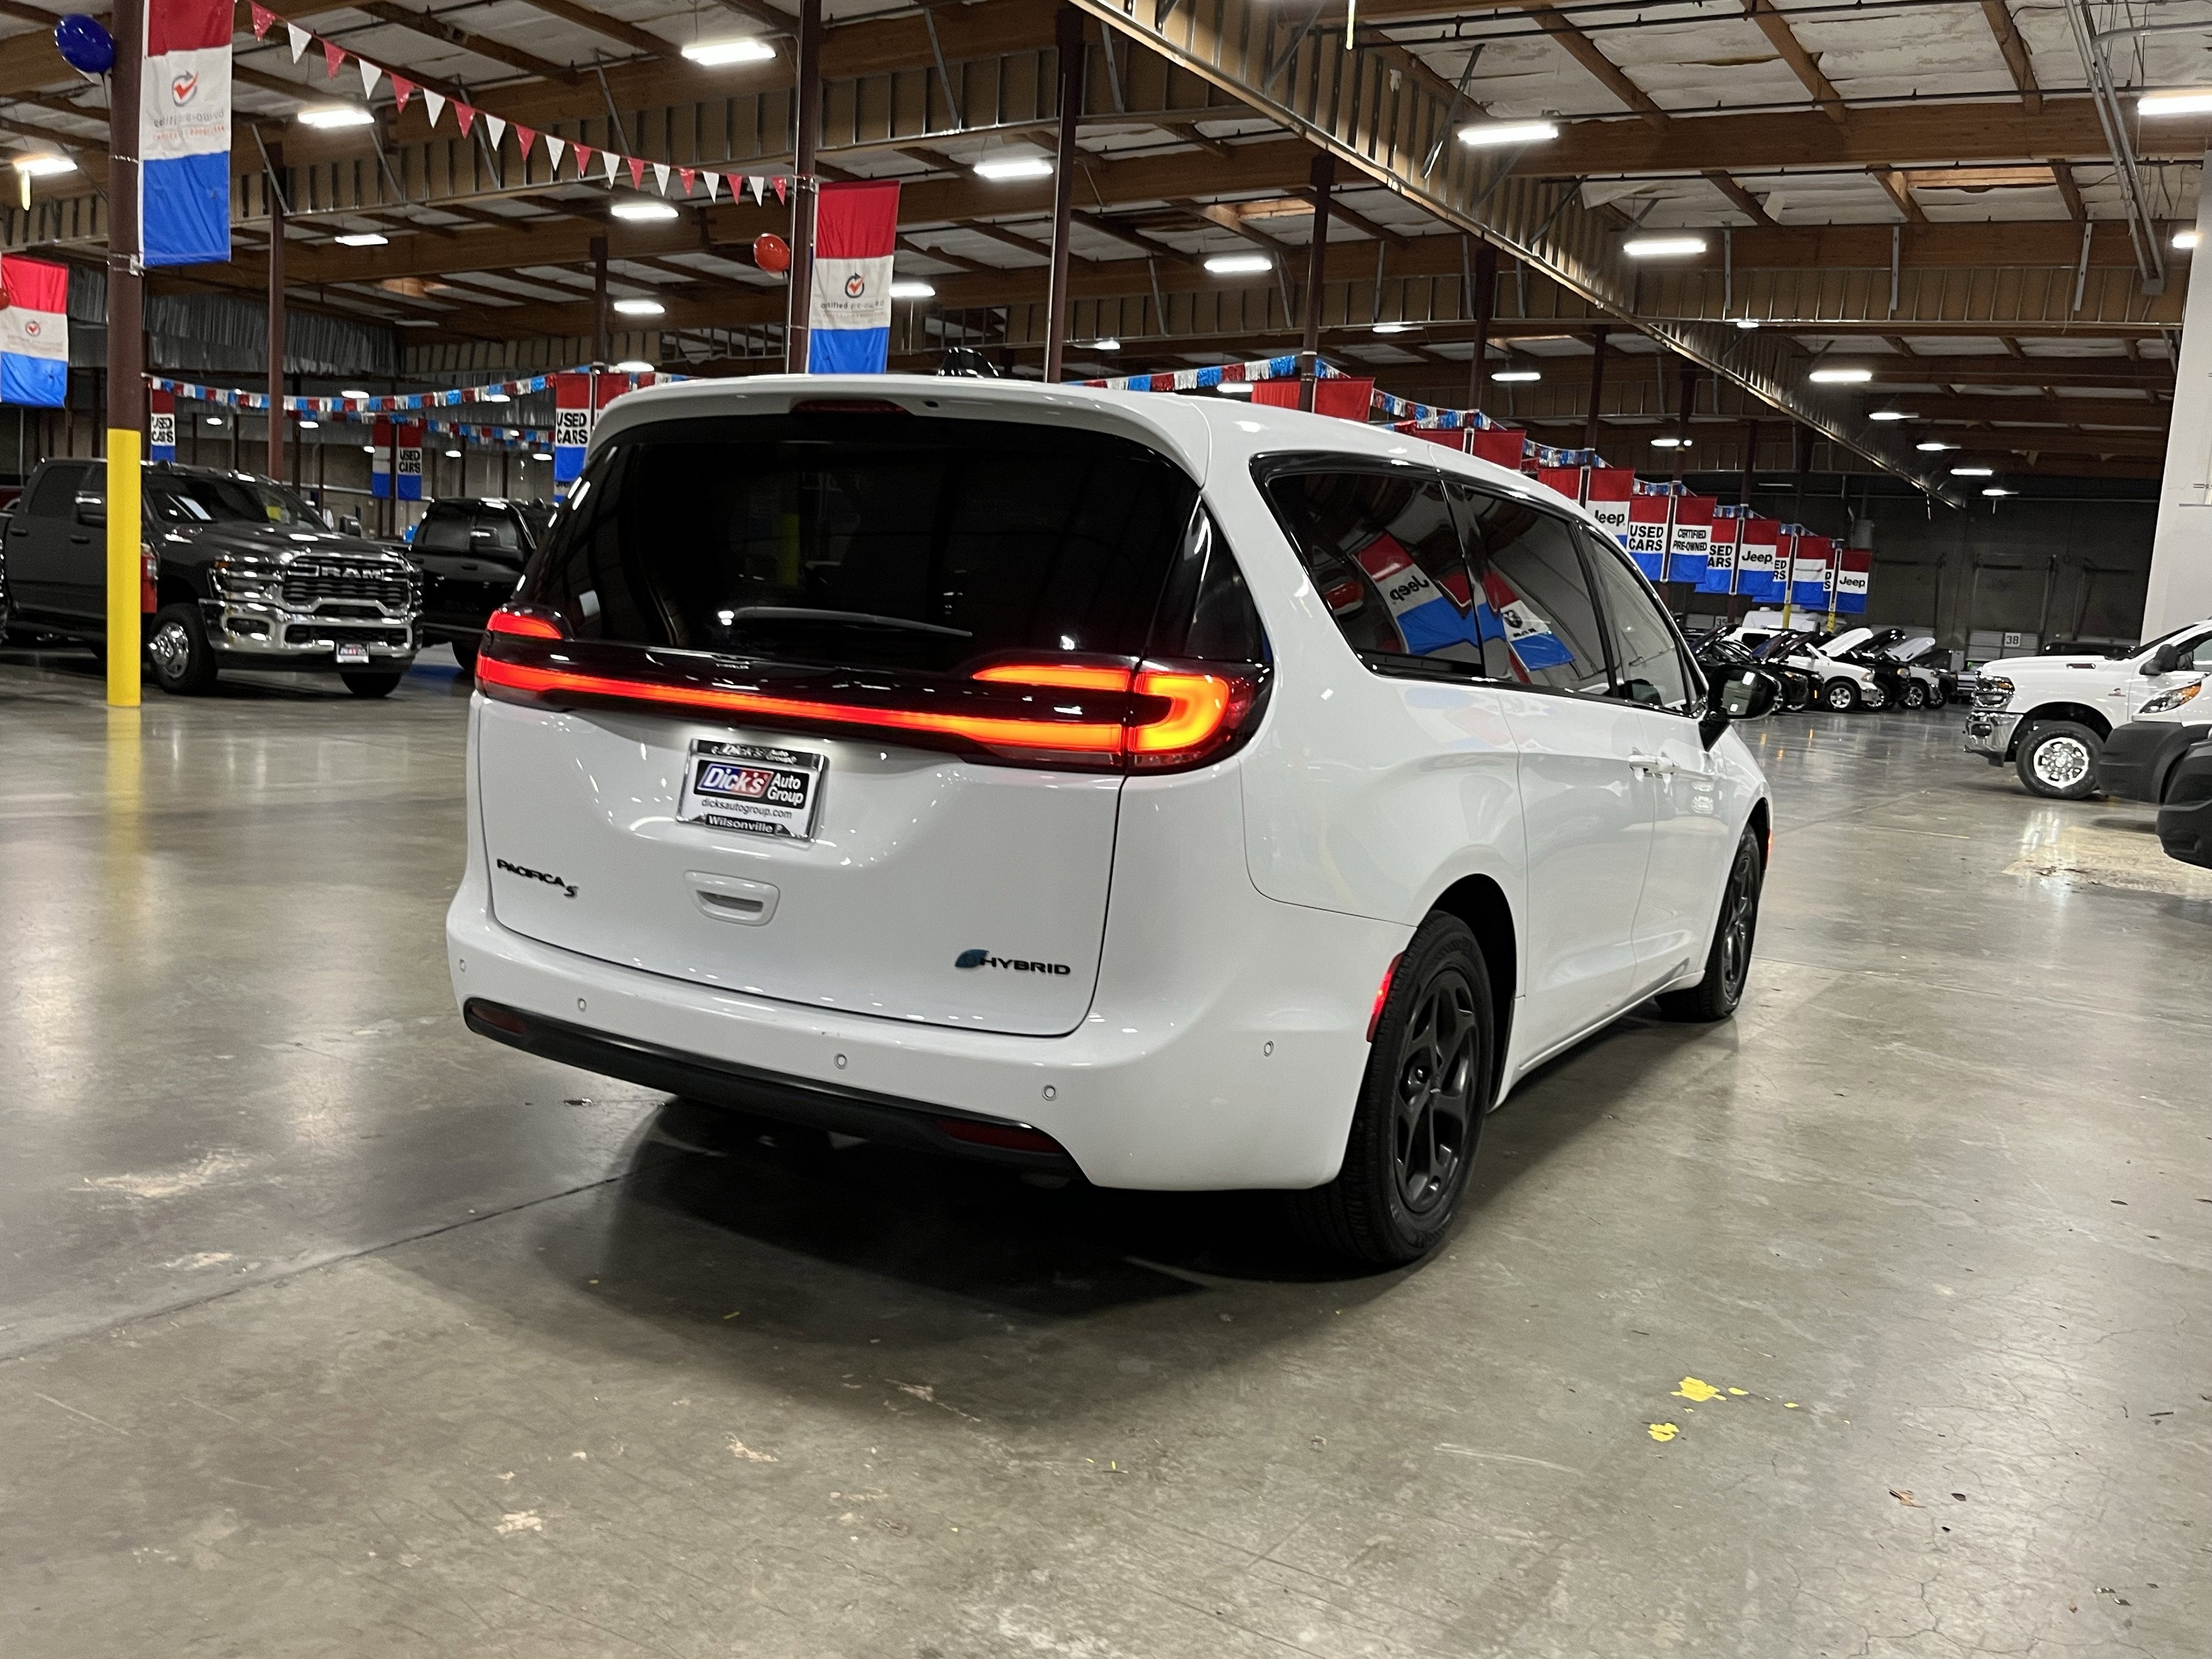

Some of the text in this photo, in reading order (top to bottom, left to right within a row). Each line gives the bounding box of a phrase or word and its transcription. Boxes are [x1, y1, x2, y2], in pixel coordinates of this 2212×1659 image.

[557, 413, 587, 427] USED
[557, 430, 588, 444] CARS
[400, 450, 420, 460] USED
[1630, 525, 1663, 538] USED
[1678, 529, 1706, 539] CERTIFIED
[1629, 539, 1663, 551] CARS
[1673, 540, 1707, 551] PRE-OWNED
[1709, 545, 1733, 556] SED
[1707, 557, 1731, 567] ARS
[1742, 551, 1773, 564] Jeep
[321, 566, 381, 579] RAM
[1839, 577, 1865, 588] Jeep
[2006, 636, 2019, 645] 38
[703, 768, 801, 794] Dick's Auto
[768, 786, 804, 806] Group
[702, 797, 792, 819] dicksautogroup.com
[709, 815, 773, 833] Wilsonville
[979, 957, 1070, 975] HYBRID
